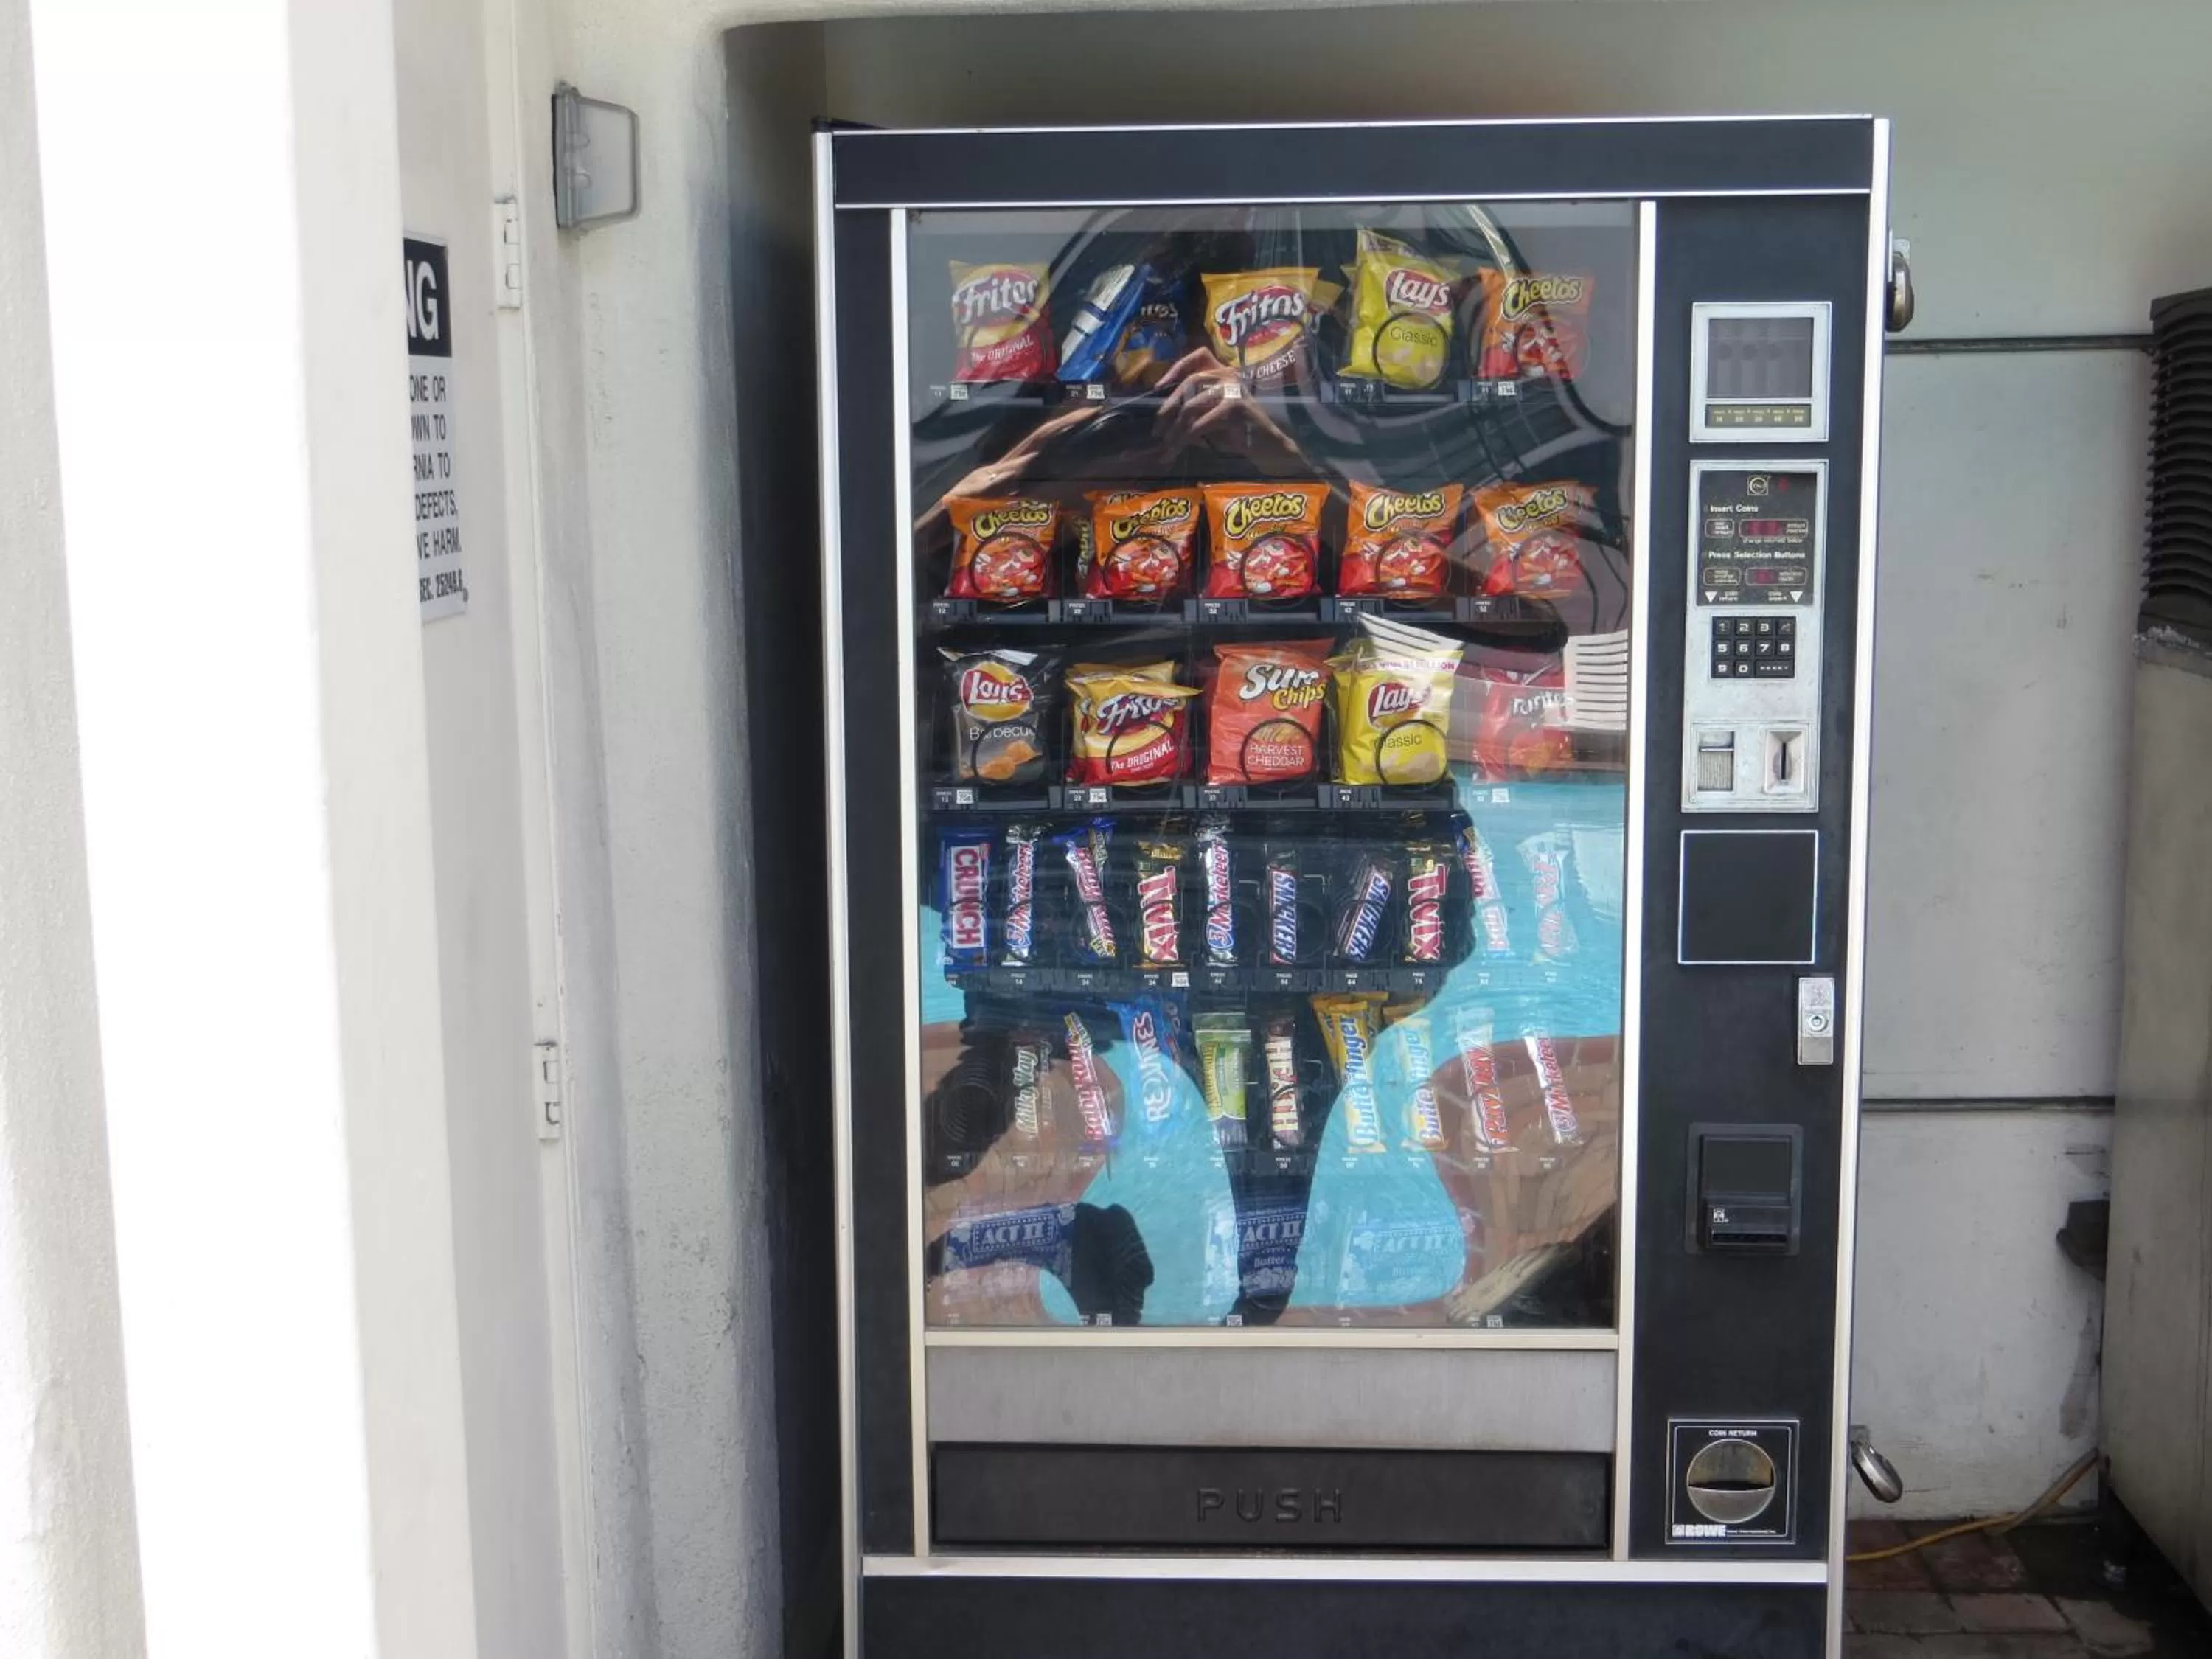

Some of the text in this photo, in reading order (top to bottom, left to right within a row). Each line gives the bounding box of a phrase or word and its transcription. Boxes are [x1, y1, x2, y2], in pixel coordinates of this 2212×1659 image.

[1387, 271, 1450, 310] Lay's
[1503, 276, 1583, 321] Cheetos
[1214, 290, 1304, 347] Fritos
[432, 375, 447, 402] OR
[433, 414, 447, 441] TO
[437, 451, 451, 479] TO
[973, 505, 1051, 539] Cheetos
[1112, 498, 1188, 540] Cheetos
[1225, 493, 1304, 536] Cheetos
[1366, 493, 1445, 529] Cheetos
[1498, 490, 1567, 532] Cheetos
[1739, 623, 1750, 632] 2
[1759, 623, 1770, 632] 3
[1717, 644, 1728, 653] 5
[1739, 644, 1749, 653] 6
[1759, 644, 1770, 653] 7
[1781, 643, 1790, 652] 8
[1239, 664, 1319, 700] Sun
[1717, 664, 1728, 672] 9
[969, 672, 1024, 706] Lay's
[1273, 683, 1326, 710] Chips
[1110, 759, 1124, 771] The
[1127, 740, 1175, 768] ORIGINAL
[1247, 755, 1304, 767] CHEDDAR
[1249, 743, 1304, 757] HARVEST
[955, 849, 982, 945] CRUNCH
[1138, 865, 1179, 961] TWIX
[1408, 863, 1447, 961] TWIX
[1273, 872, 1297, 962] SNICKERS
[1348, 873, 1390, 962] SNICKERS
[1013, 1048, 1039, 1087] Way
[1406, 1025, 1442, 1141] Butteinger
[982, 1222, 1045, 1245] ACT II
[1243, 1220, 1303, 1242] ACT II
[1197, 1487, 1342, 1523] PUSH
[1685, 1524, 1726, 1537] ROWE
